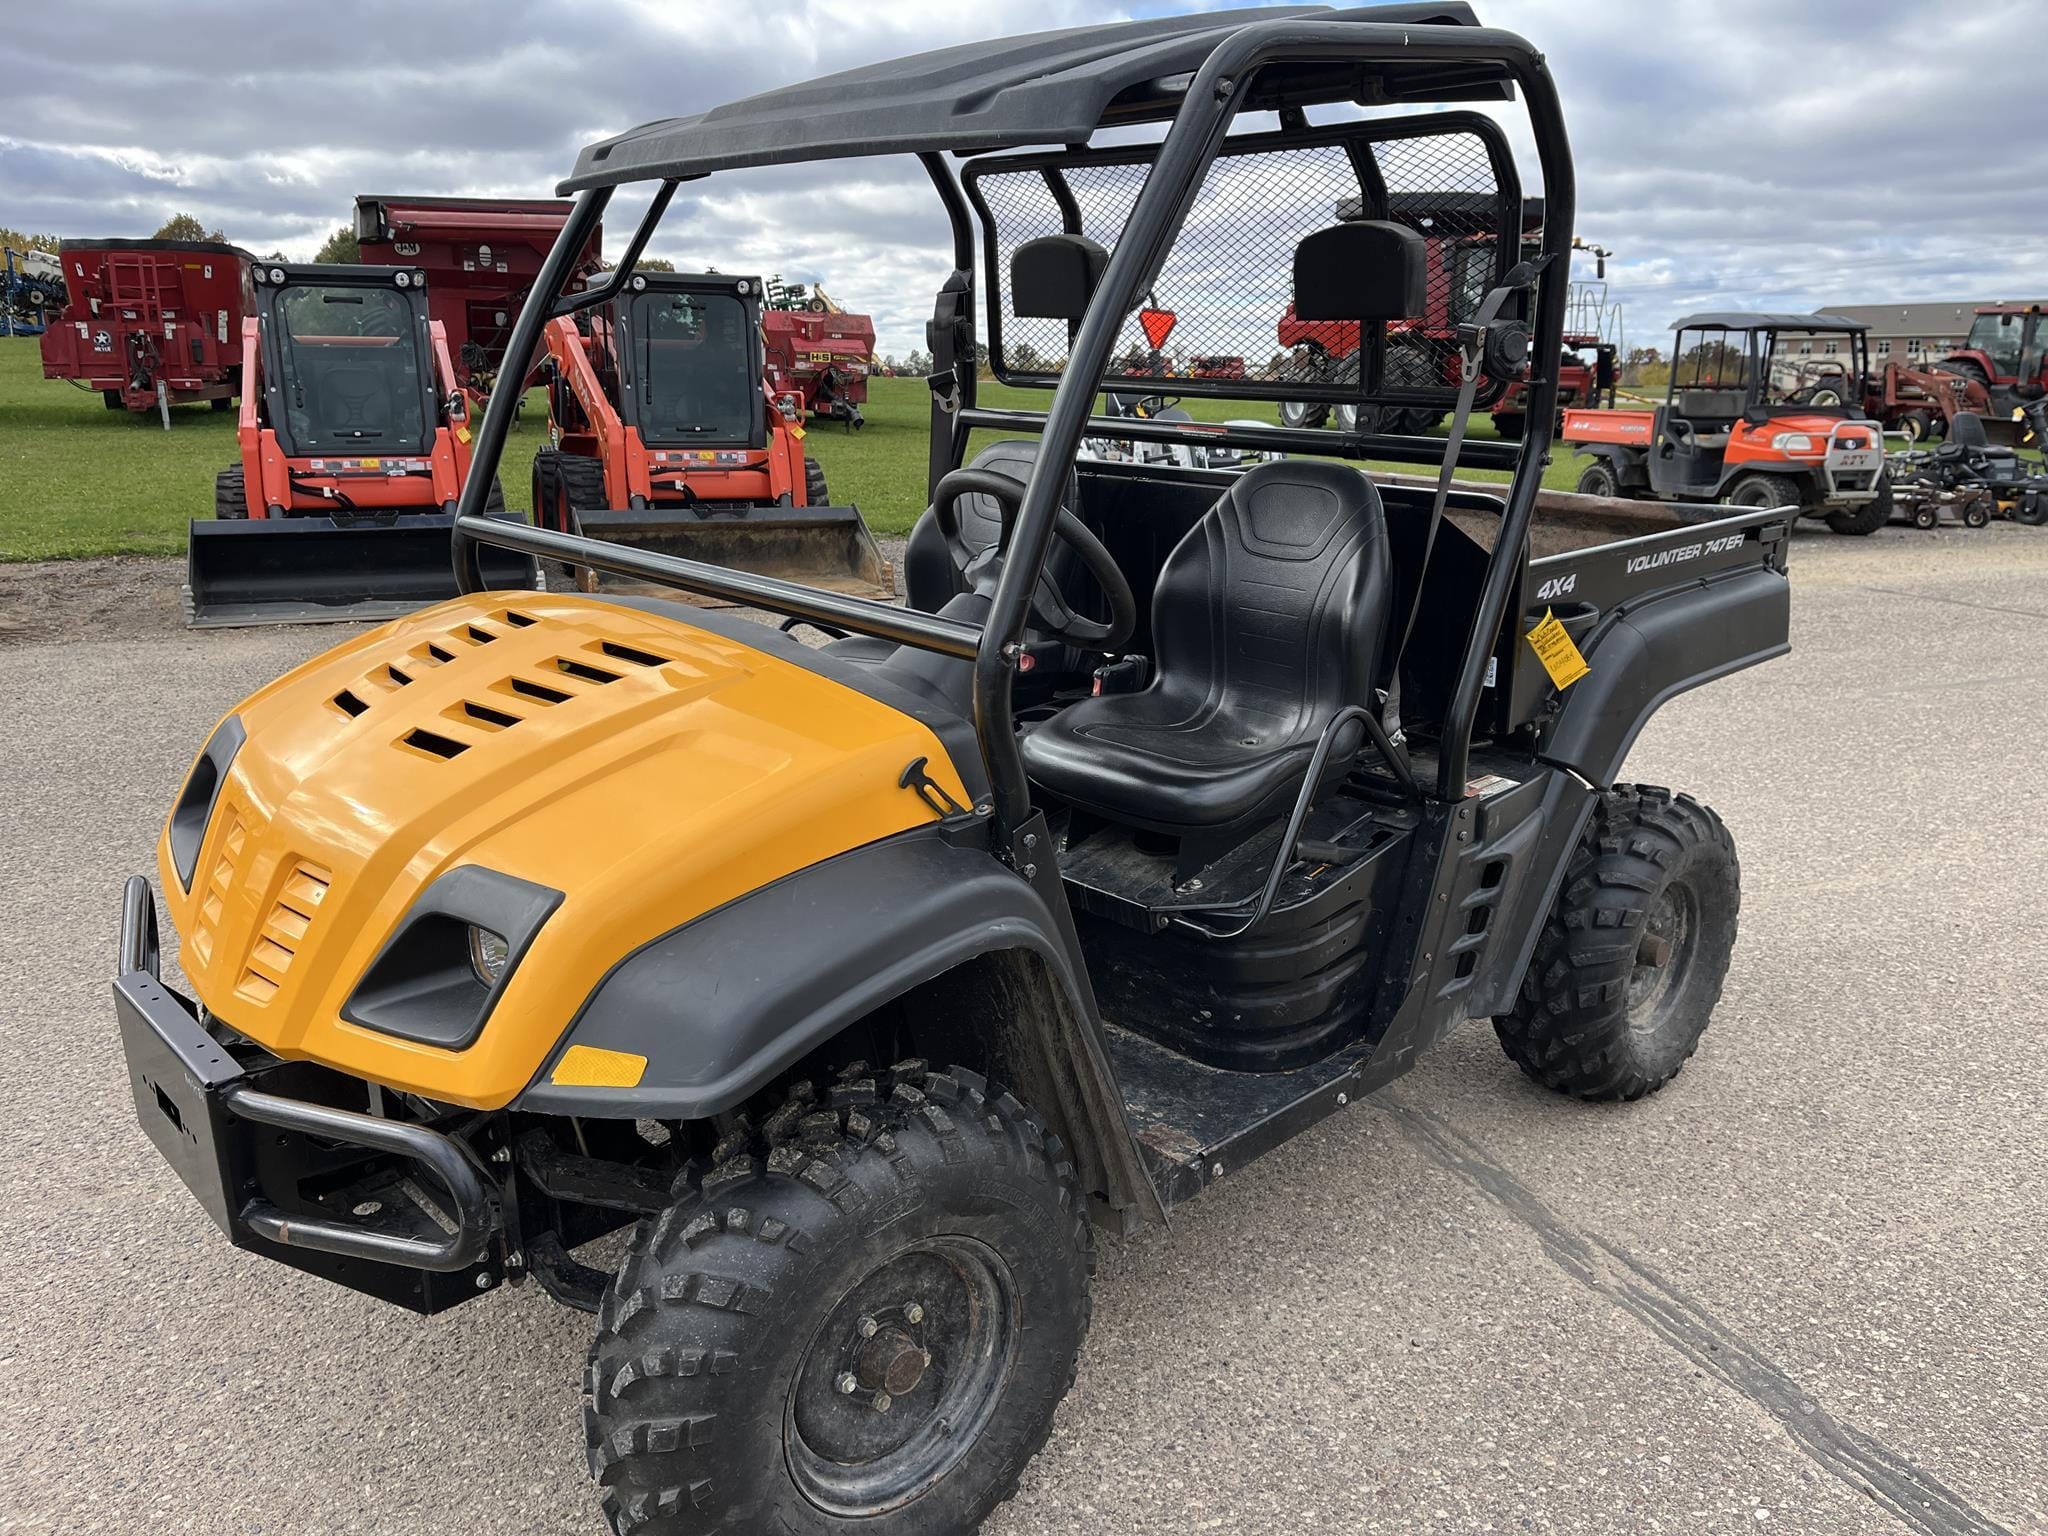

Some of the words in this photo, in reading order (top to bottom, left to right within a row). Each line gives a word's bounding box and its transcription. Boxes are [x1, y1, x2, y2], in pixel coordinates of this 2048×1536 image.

[1626, 543, 1701, 574] VOLUNTEER
[1703, 533, 1746, 557] 747EFI
[1536, 573, 1577, 600] 4X4
